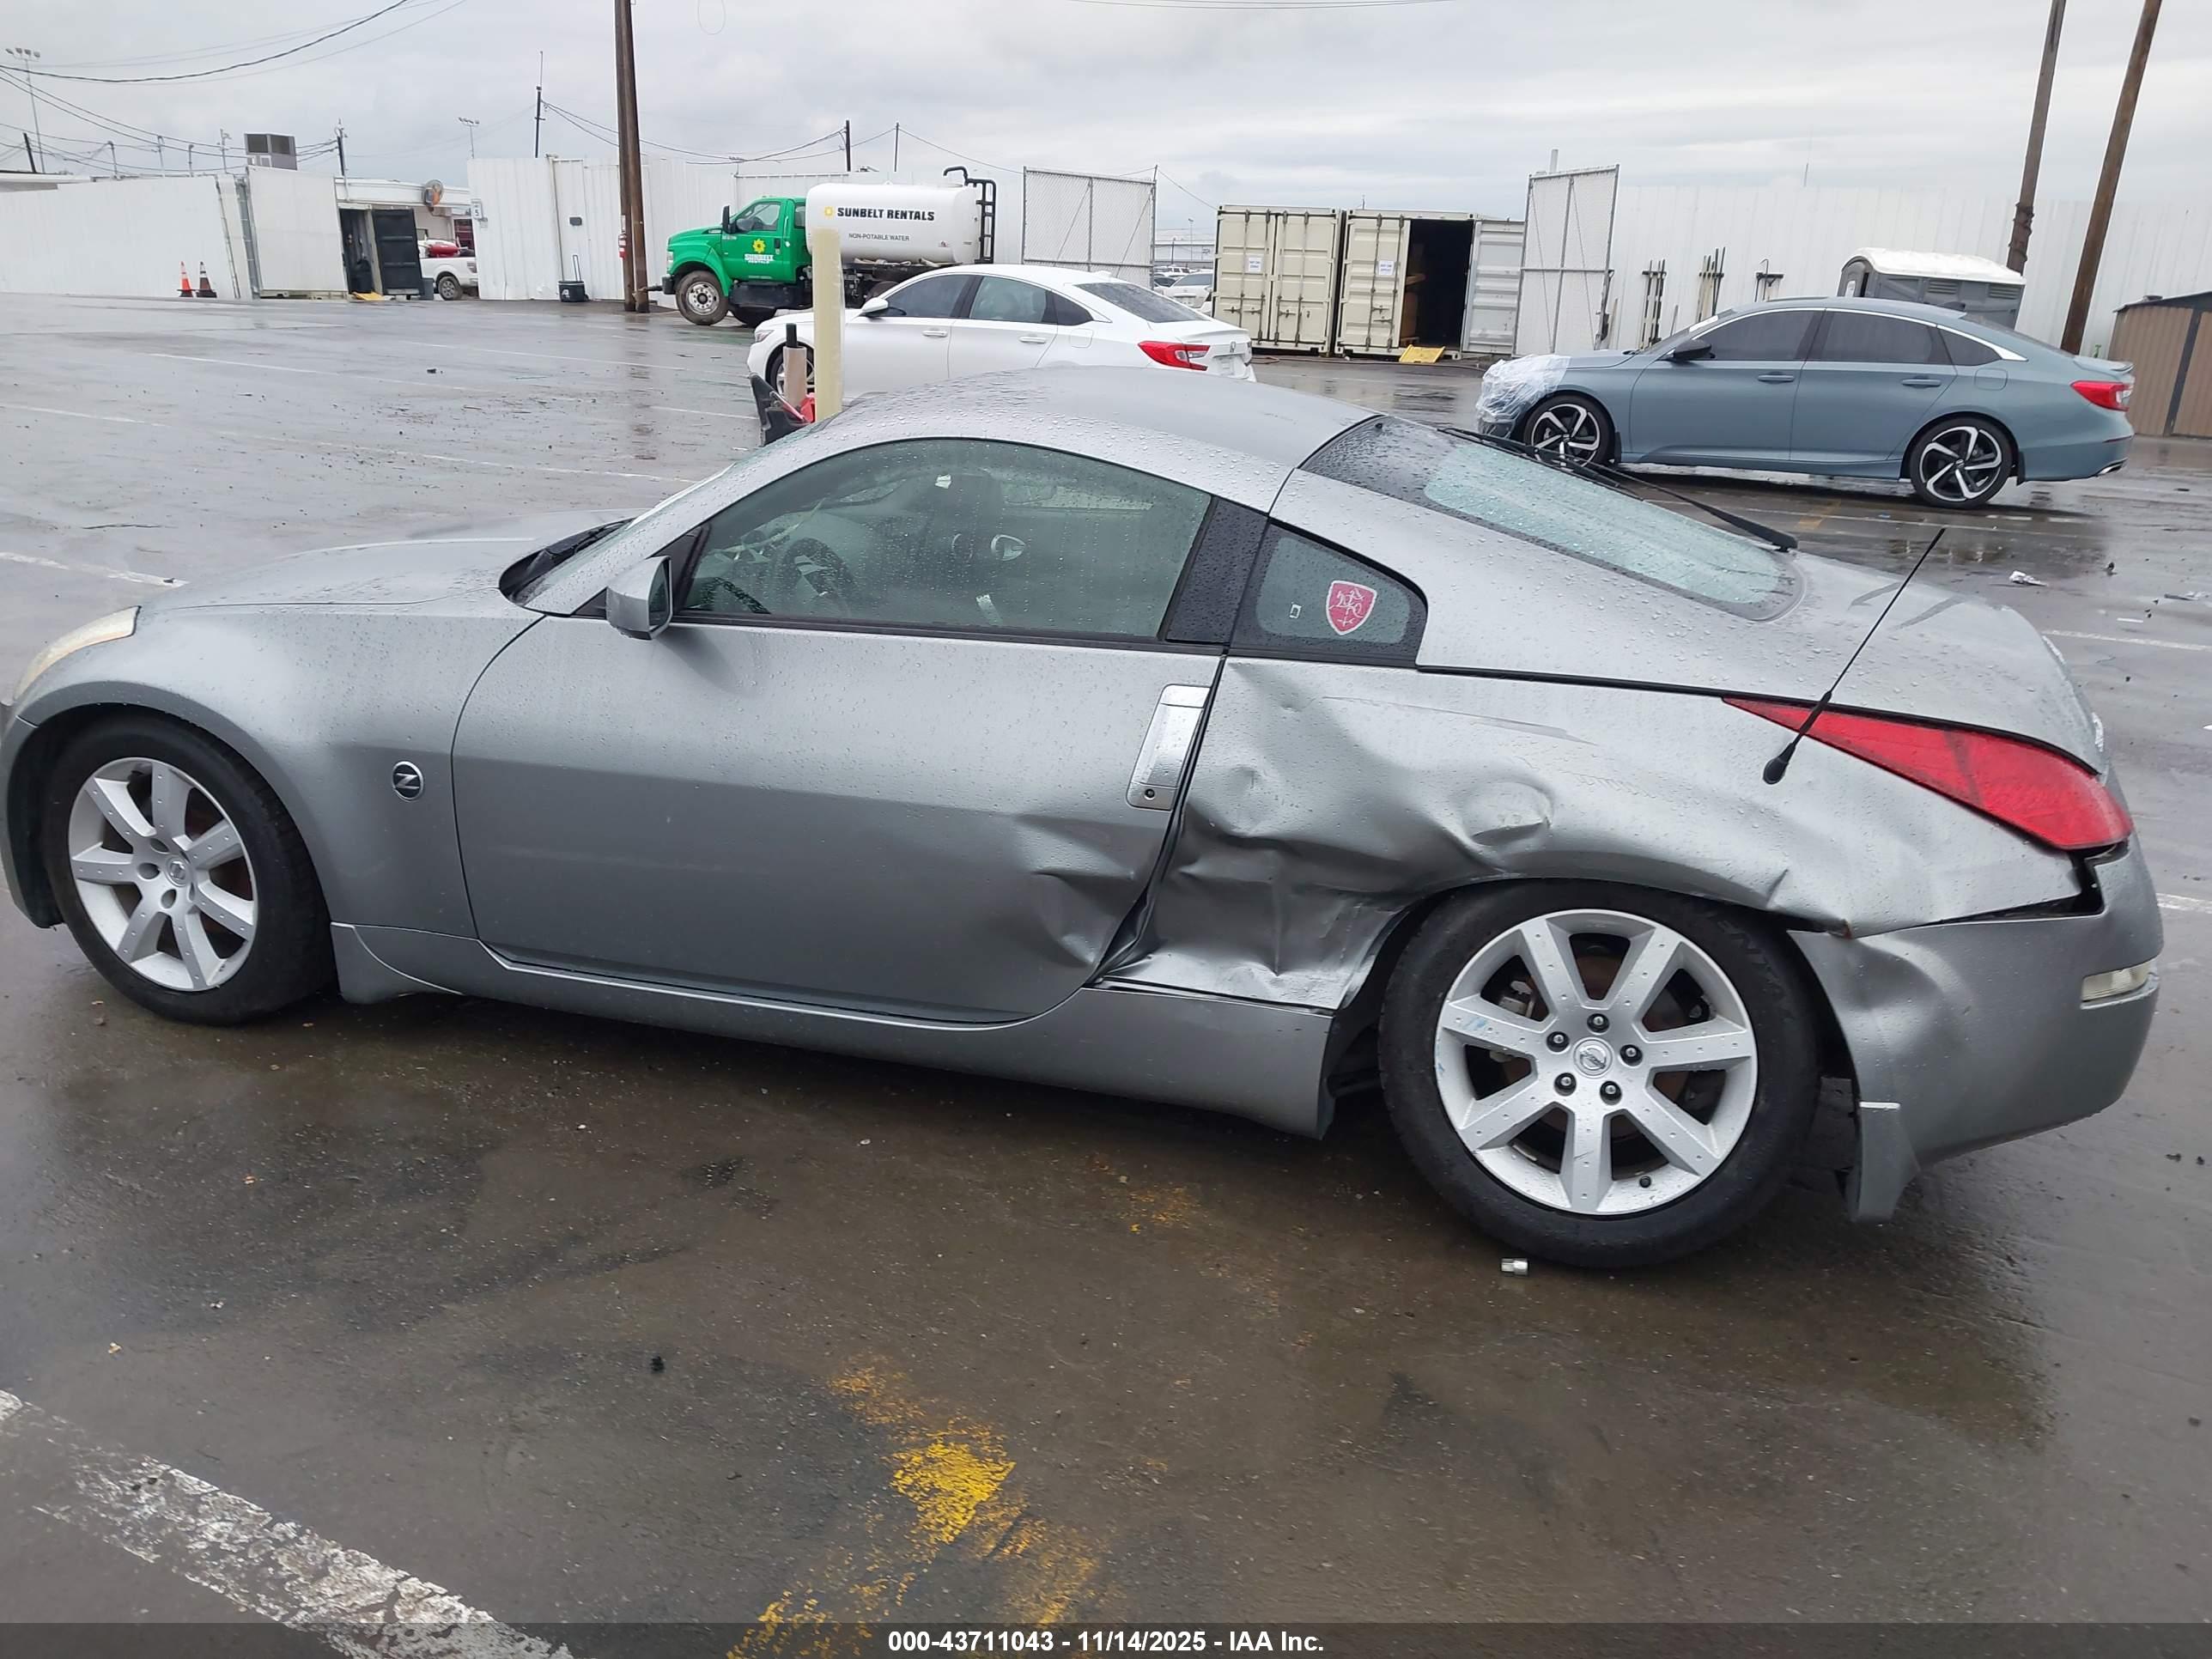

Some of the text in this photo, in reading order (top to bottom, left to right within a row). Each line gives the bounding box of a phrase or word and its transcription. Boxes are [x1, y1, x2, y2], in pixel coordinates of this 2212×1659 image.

[837, 207, 935, 222] SUNBELT RENTALS
[848, 233, 889, 241] NON-POTABLE
[395, 772, 420, 790] Z
